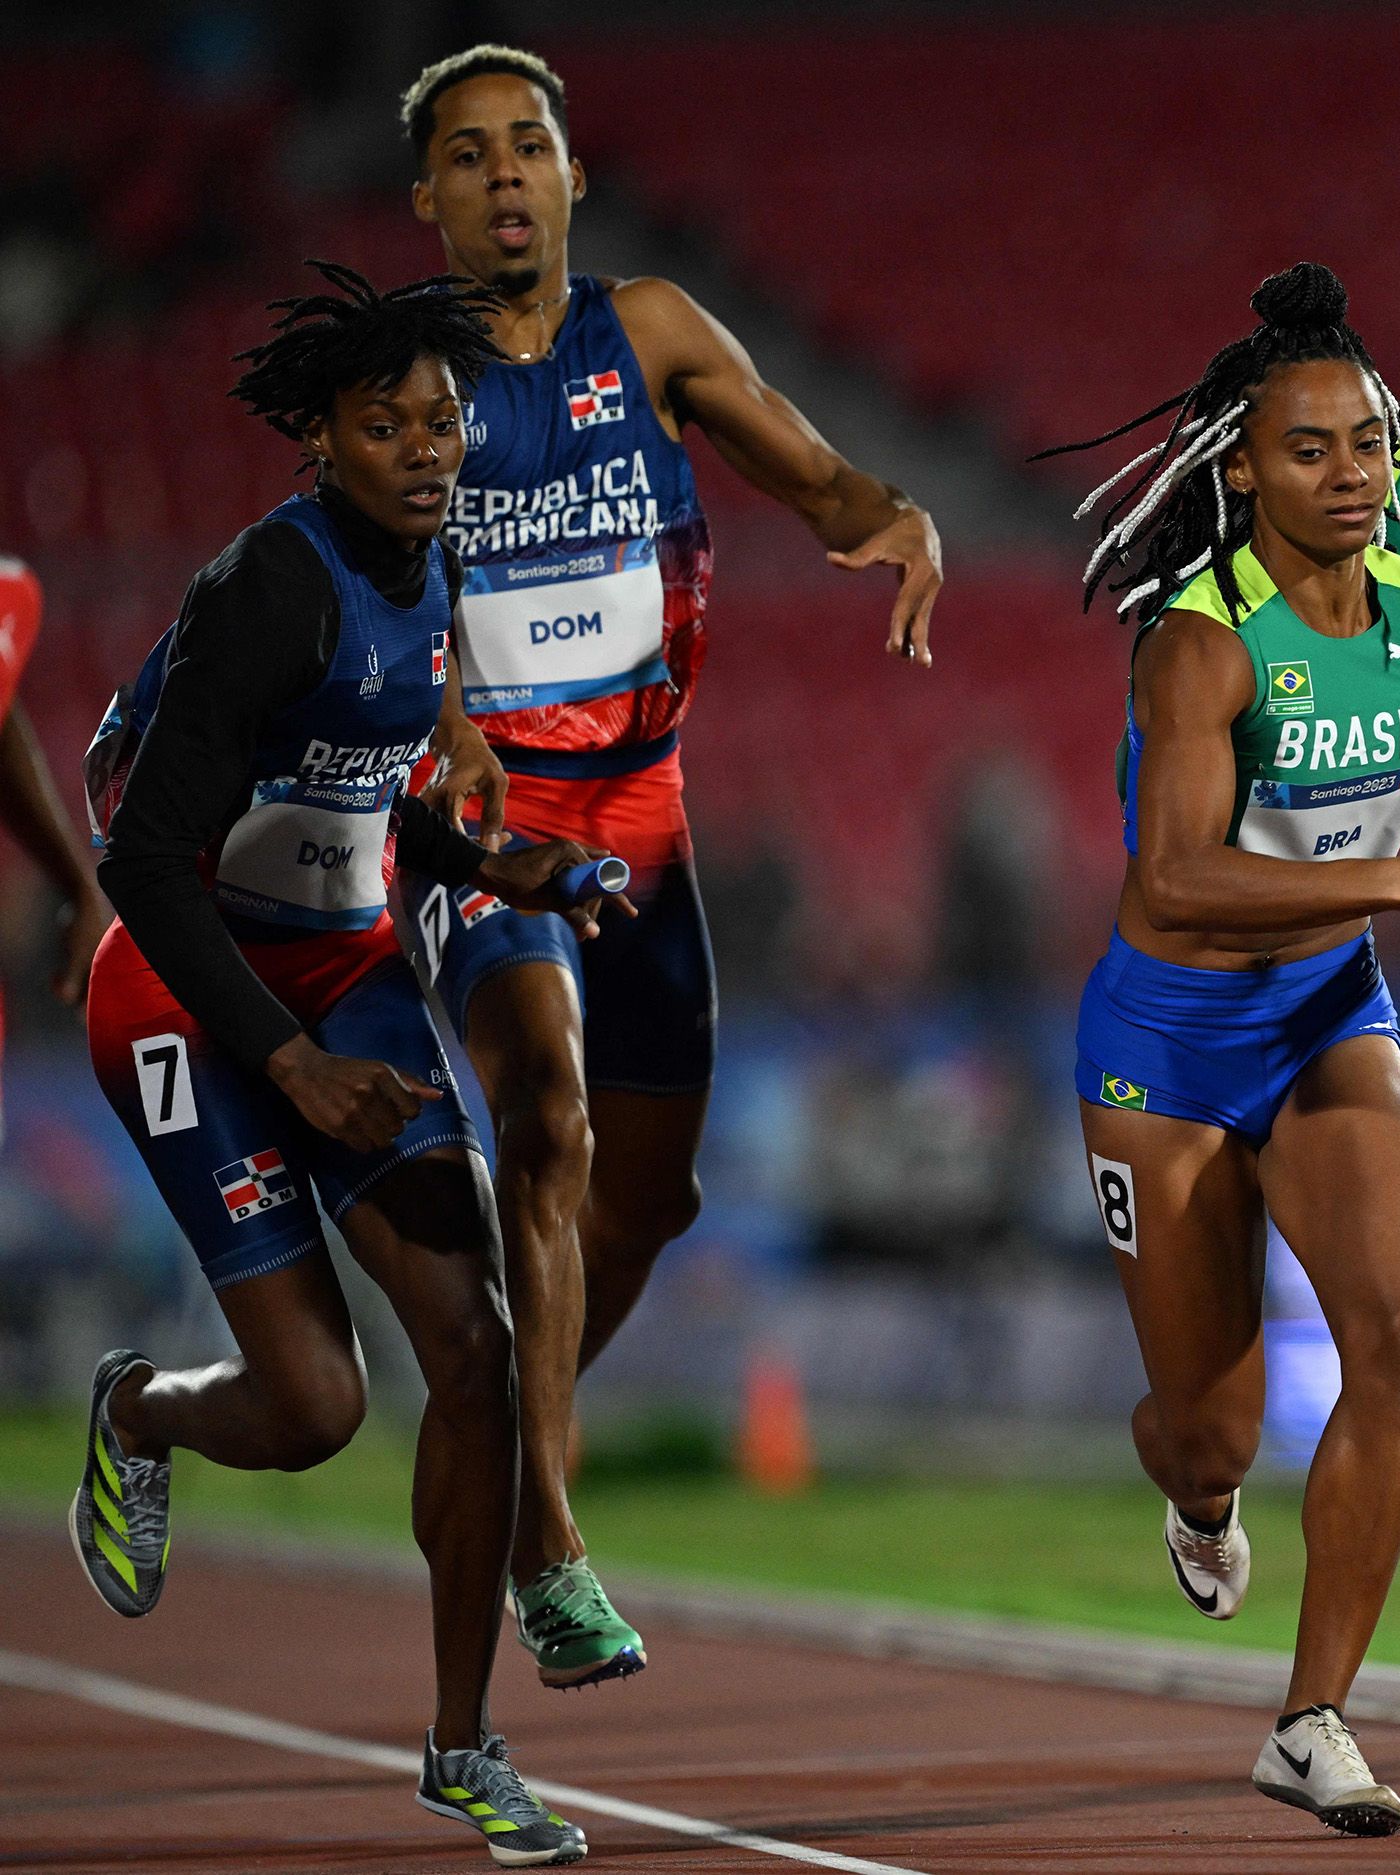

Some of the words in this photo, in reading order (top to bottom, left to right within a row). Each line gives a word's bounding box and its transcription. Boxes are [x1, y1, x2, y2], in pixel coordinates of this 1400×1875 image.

[446, 449, 651, 524] EPUBLICA
[446, 498, 664, 557] OMINICANA
[529, 611, 603, 645] DOM
[296, 840, 355, 871] DOM
[1313, 824, 1363, 856] BRA
[142, 1044, 179, 1123] 7
[235, 1188, 293, 1219] DOM
[1099, 1169, 1133, 1243] 8
